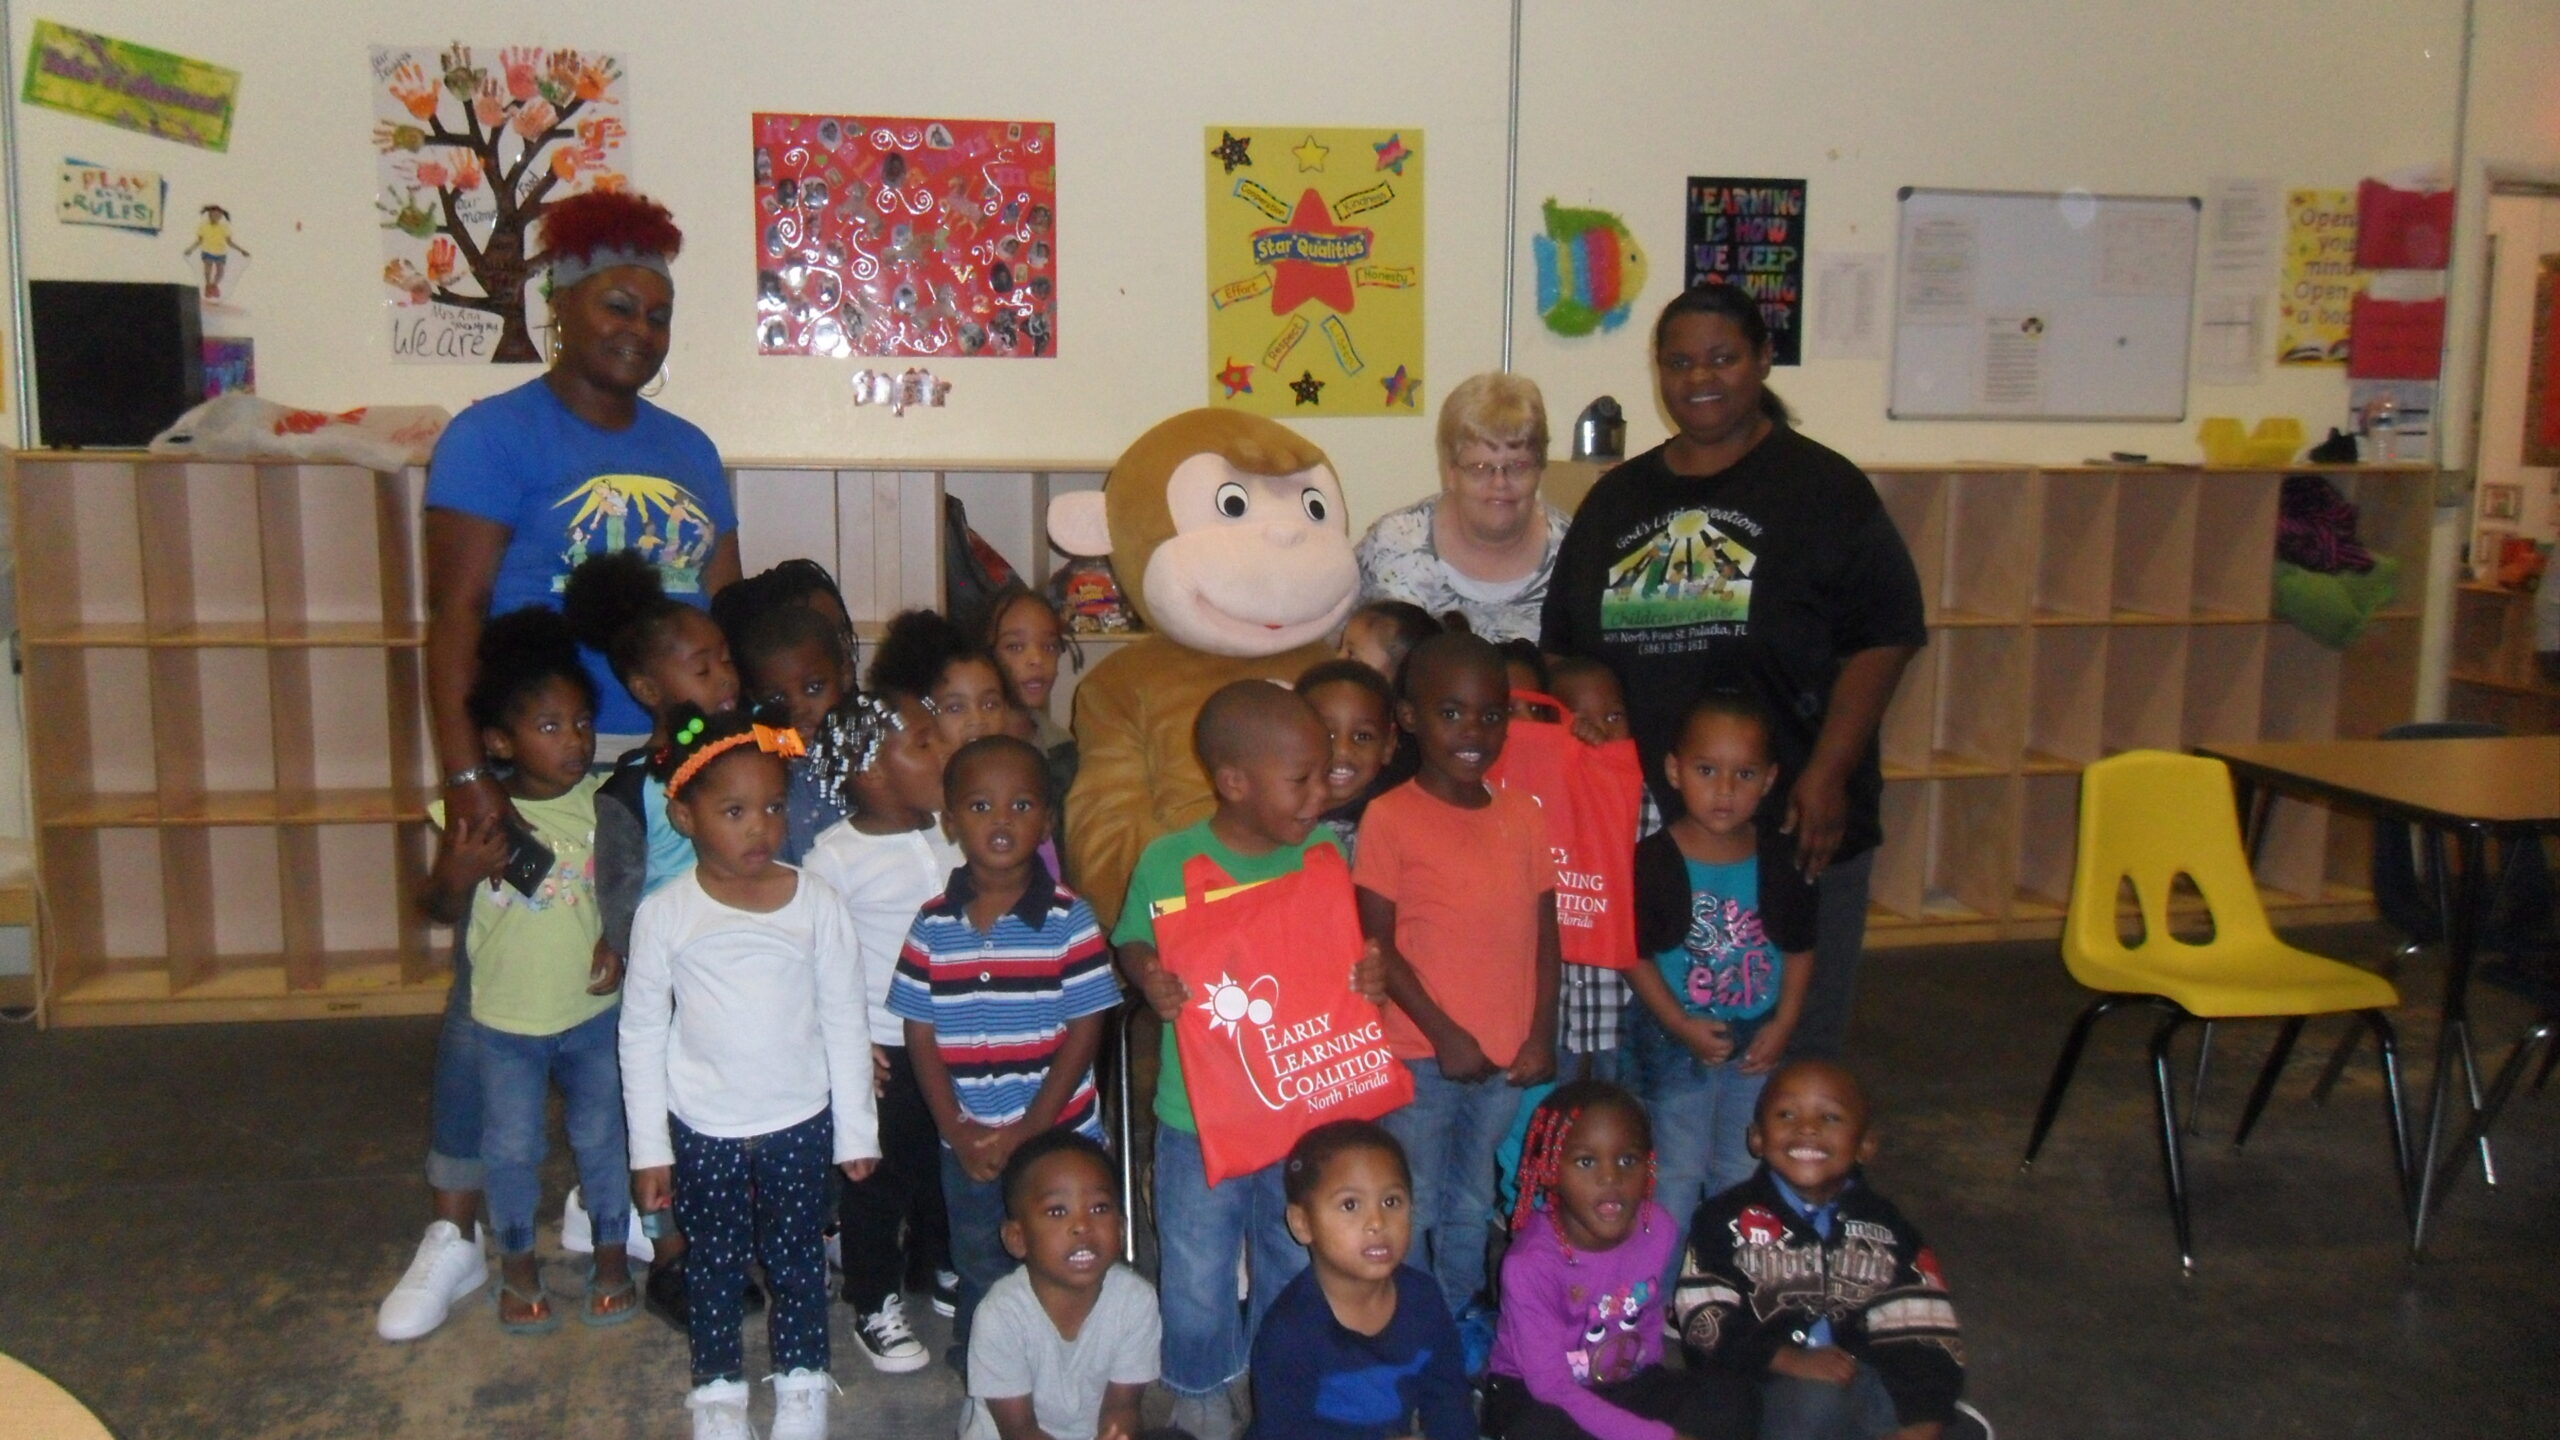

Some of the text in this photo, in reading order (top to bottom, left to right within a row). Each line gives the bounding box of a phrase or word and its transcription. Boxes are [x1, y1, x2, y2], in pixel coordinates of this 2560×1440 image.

[1344, 191, 1388, 212] Kindness
[1690, 187, 1802, 216] LEARNING
[1705, 215, 1788, 243] IS HOW
[1257, 238, 1365, 259] Star Qualities
[1693, 244, 1797, 272] WE KEEP
[1225, 281, 1258, 299] Effort
[1363, 269, 1408, 283] Honesty
[394, 318, 428, 357] We
[436, 327, 485, 357] are
[1268, 322, 1302, 361] Respect
[1620, 630, 1648, 643] North
[1735, 623, 1748, 637] FL
[1259, 1012, 1332, 1054] EARLY
[1268, 1021, 1383, 1079] LEARNING
[1277, 1045, 1394, 1102] COALITION
[1308, 1073, 1389, 1114] North Florida
